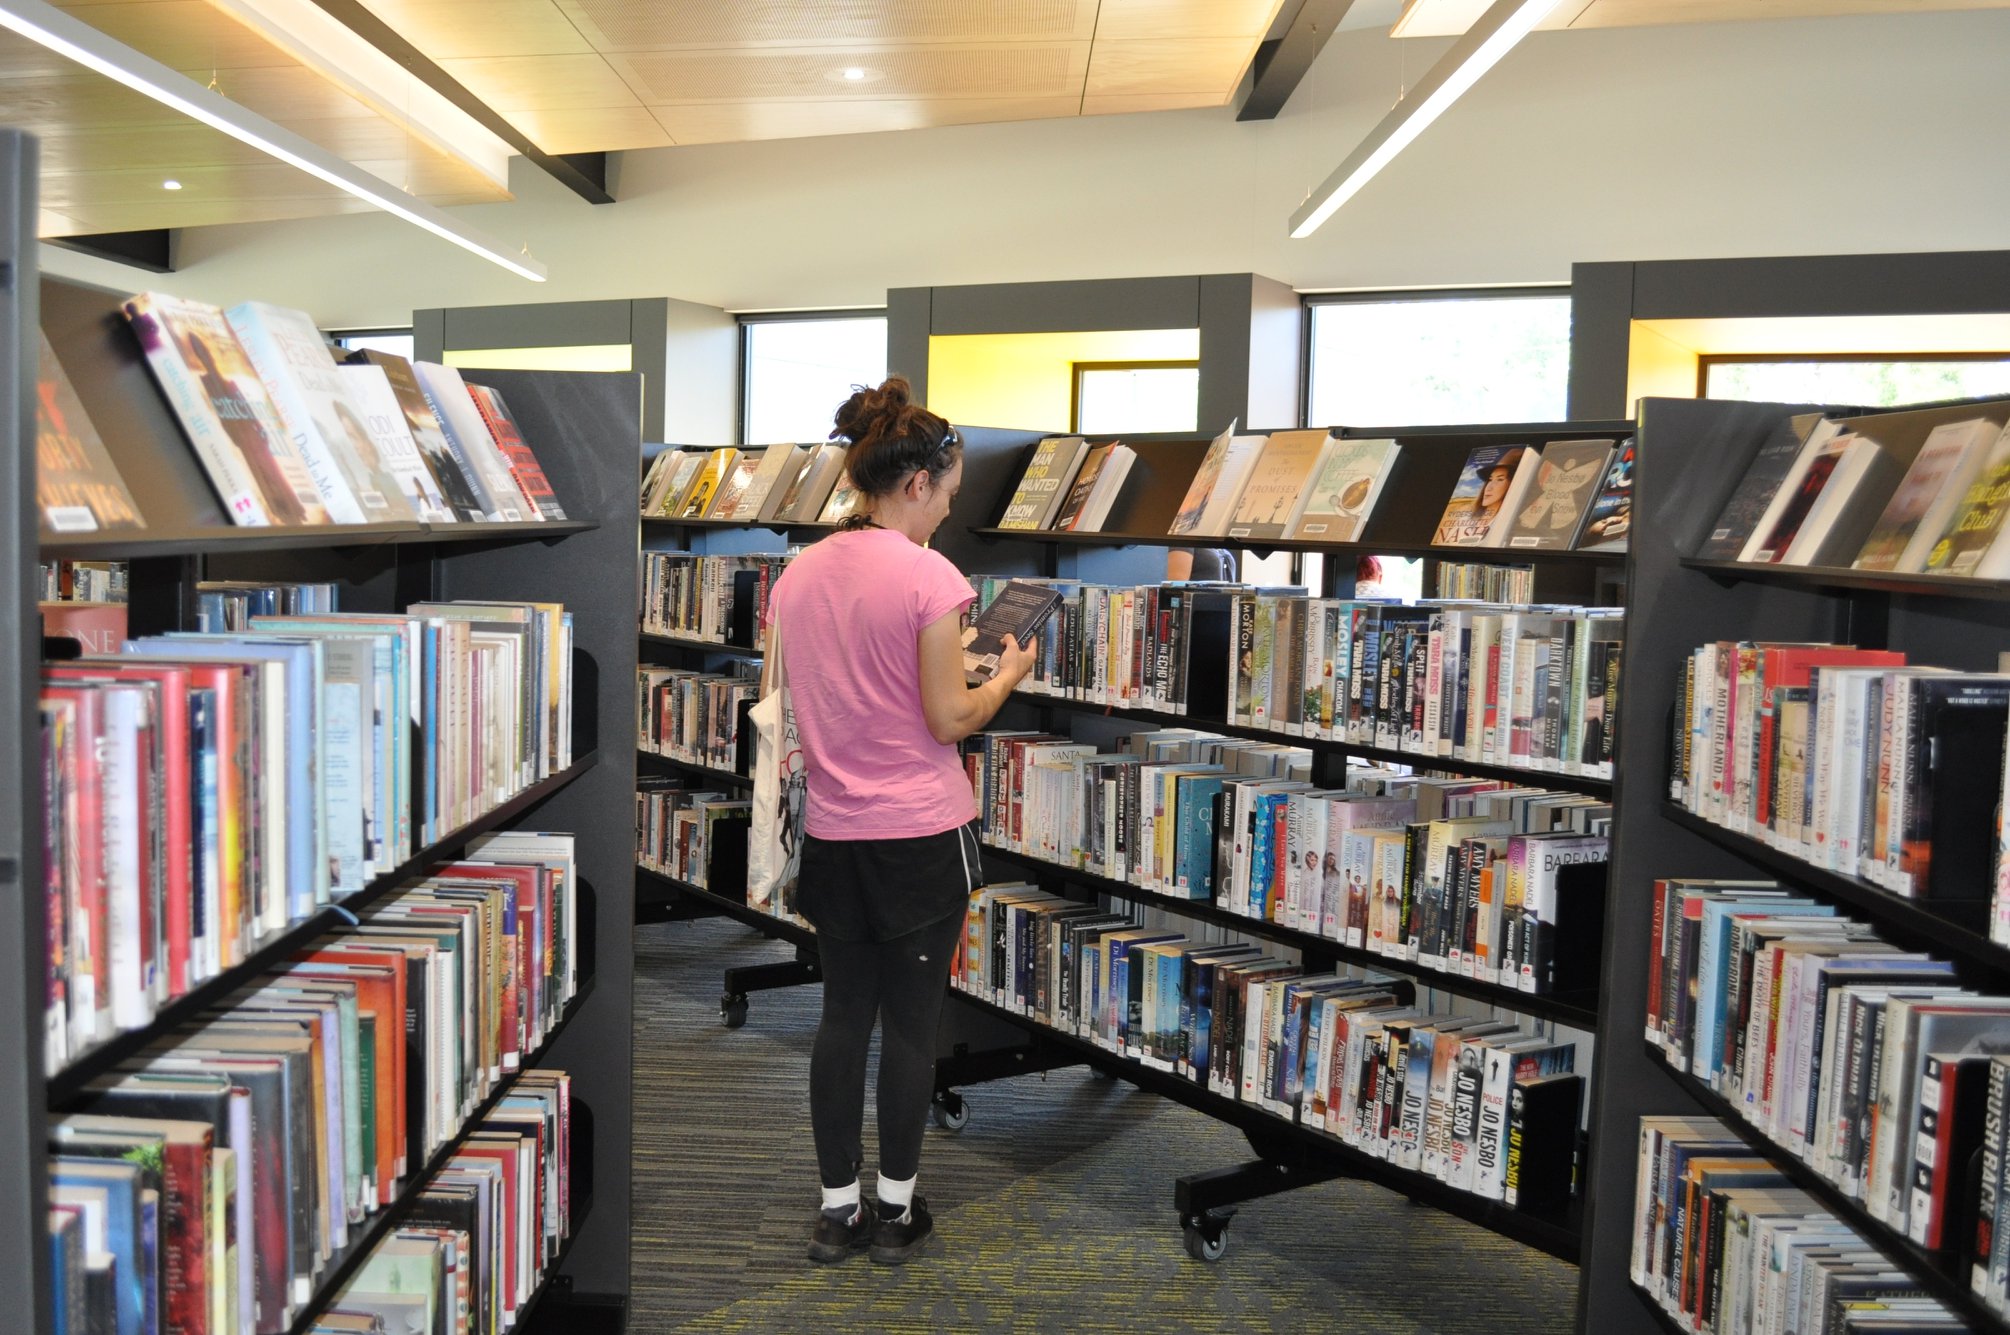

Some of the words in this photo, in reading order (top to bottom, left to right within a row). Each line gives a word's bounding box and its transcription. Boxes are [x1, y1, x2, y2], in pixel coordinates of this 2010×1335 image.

[1030, 453, 1055, 466] MAN
[1037, 440, 1059, 453] THE
[293, 432, 320, 473] Dead
[317, 475, 334, 501] Me
[1025, 466, 1049, 478] WHO
[1012, 492, 1026, 504] TO
[1017, 478, 1060, 492] WANTED
[1003, 504, 1037, 518] KNOW
[1551, 502, 1576, 514] Snow
[1437, 527, 1490, 544] NASH
[1242, 605, 1250, 649] MORTON
[1336, 615, 1349, 676] MOSLEY
[1353, 640, 1363, 668] TARA
[1431, 636, 1441, 663] TARA
[1157, 655, 1168, 677] ECHO
[1381, 658, 1390, 682] TARA
[1416, 650, 1424, 674] SPLIT
[1548, 637, 1563, 687] DARKTOWN
[1608, 660, 1617, 682] Alice
[1351, 669, 1362, 699] MOSS
[1430, 666, 1440, 695] MOSS
[1335, 681, 1343, 713] CHARCOAL
[1380, 684, 1389, 709] MOSS
[1883, 683, 1895, 735] JUDY
[1896, 681, 1906, 735] MALLA
[1603, 713, 1613, 734] Dear
[1907, 694, 1917, 739] MALLA
[1051, 750, 1080, 760] SANTA
[1603, 736, 1612, 753] Life
[1880, 739, 1892, 794] NUNN
[1894, 737, 1904, 781] NUNN
[1907, 744, 1915, 784] NUNN
[1223, 792, 1231, 827] MURAKAMI
[1287, 801, 1297, 848] MURRAY
[1429, 831, 1440, 873] MURRAY
[1472, 847, 1483, 871] AMY
[1526, 843, 1536, 880] BARBARA
[1468, 874, 1481, 908] MYERS
[1525, 882, 1534, 906] NADEL
[1112, 946, 1119, 955] Di
[1754, 981, 1763, 1008] DEATH
[1225, 1016, 1233, 1044] NADEL
[1754, 1012, 1761, 1023] OF
[1854, 1005, 1866, 1035] NICK
[1874, 1010, 1886, 1040] NICK
[1752, 1025, 1760, 1048] BEES
[1266, 1050, 1274, 1079] ENOUGH
[1735, 1046, 1744, 1075] Chalk
[1796, 1044, 1810, 1092] Faithfully
[1849, 1038, 1864, 1096] OLDHAM
[1265, 1080, 1273, 1098] ROPE
[1386, 1074, 1393, 1082] JO
[1456, 1072, 1476, 1091] JO
[1811, 1072, 1819, 1087] the
[1365, 1100, 1372, 1108] JO
[1405, 1091, 1421, 1108] JO
[1429, 1094, 1443, 1111] JO
[1482, 1092, 1504, 1106] POLICE
[1984, 1060, 2005, 1152] BRUSH
[1453, 1093, 1474, 1137] NESBO
[1482, 1105, 1500, 1124] JO
[1452, 1141, 1464, 1163] SON
[1478, 1125, 1499, 1169] NESBO
[1508, 1128, 1522, 1149] JO
[1979, 1152, 2000, 1219] BACK
[1673, 1207, 1685, 1256] NATURAL
[1805, 1264, 1813, 1296] LYNDA
